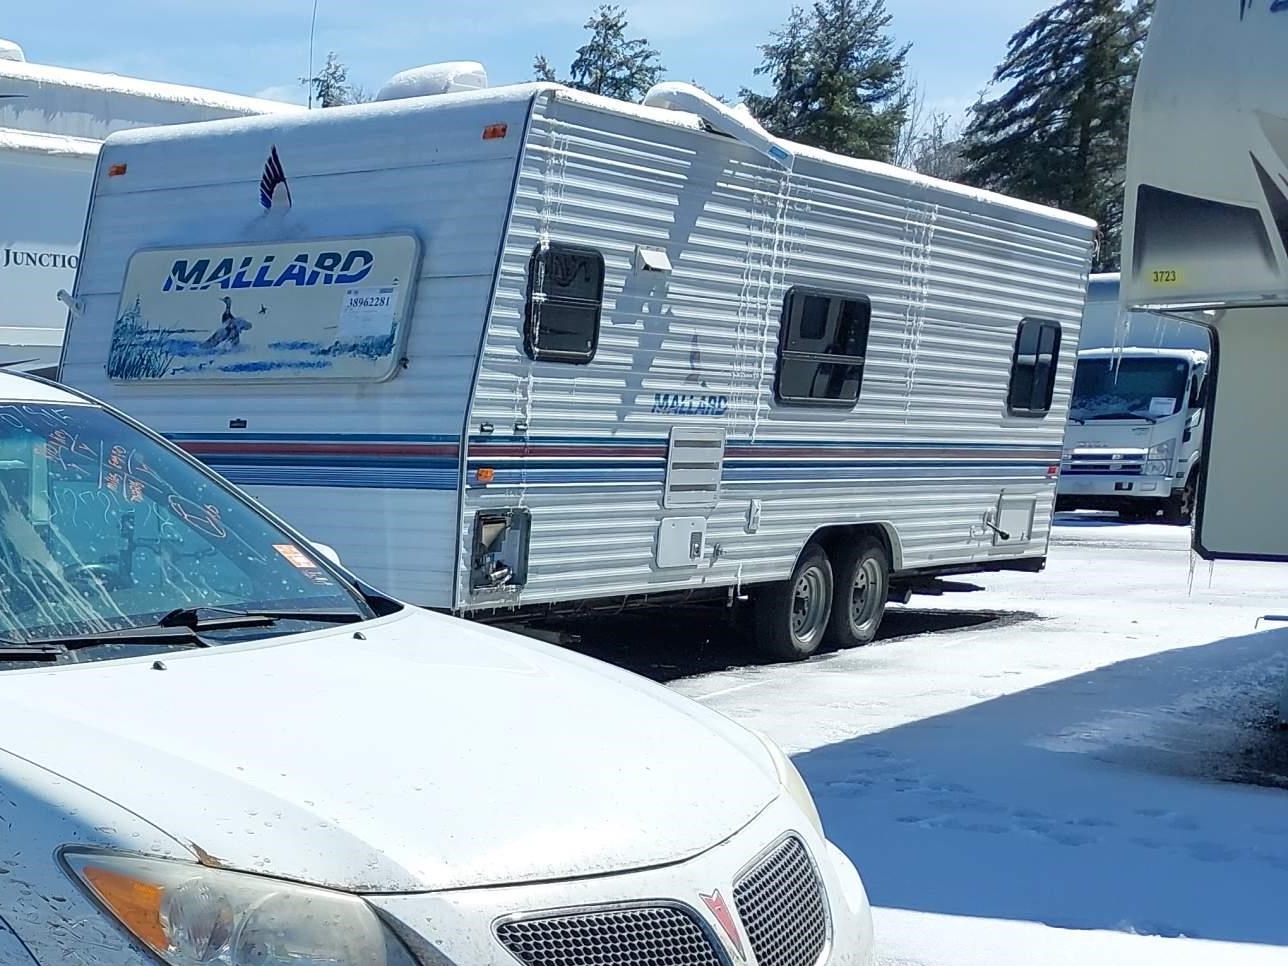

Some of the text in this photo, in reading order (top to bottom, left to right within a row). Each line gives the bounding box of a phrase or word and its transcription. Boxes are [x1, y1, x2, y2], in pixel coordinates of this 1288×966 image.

[4, 248, 79, 269] JUNCTIO
[162, 249, 374, 292] MALLARD
[1152, 270, 1176, 282] 3723
[651, 392, 728, 415] MALLARD
